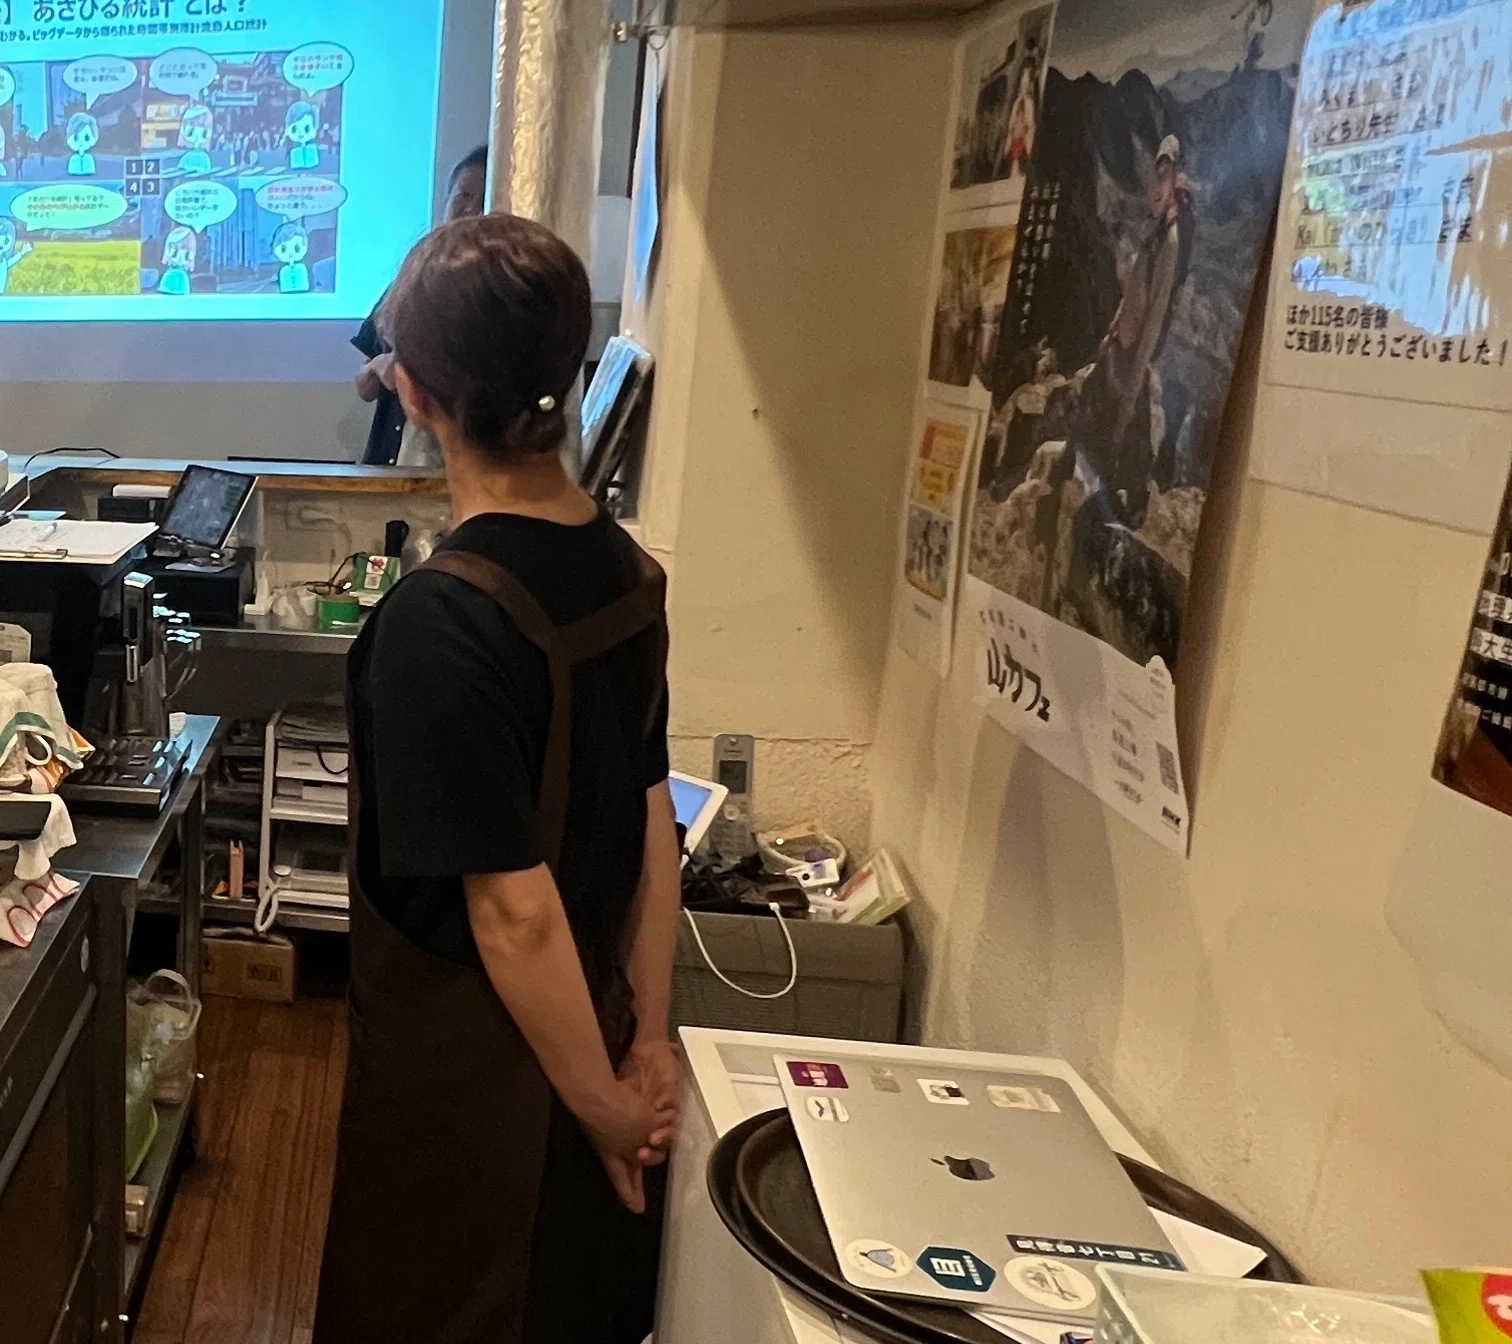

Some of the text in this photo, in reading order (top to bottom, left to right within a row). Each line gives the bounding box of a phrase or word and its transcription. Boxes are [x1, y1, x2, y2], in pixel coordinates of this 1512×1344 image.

[1285, 304, 1389, 330] ほか115名の皆様
[1283, 327, 1509, 368] ご支援ありがとうございました！
[987, 636, 1051, 723] 山カフェ
